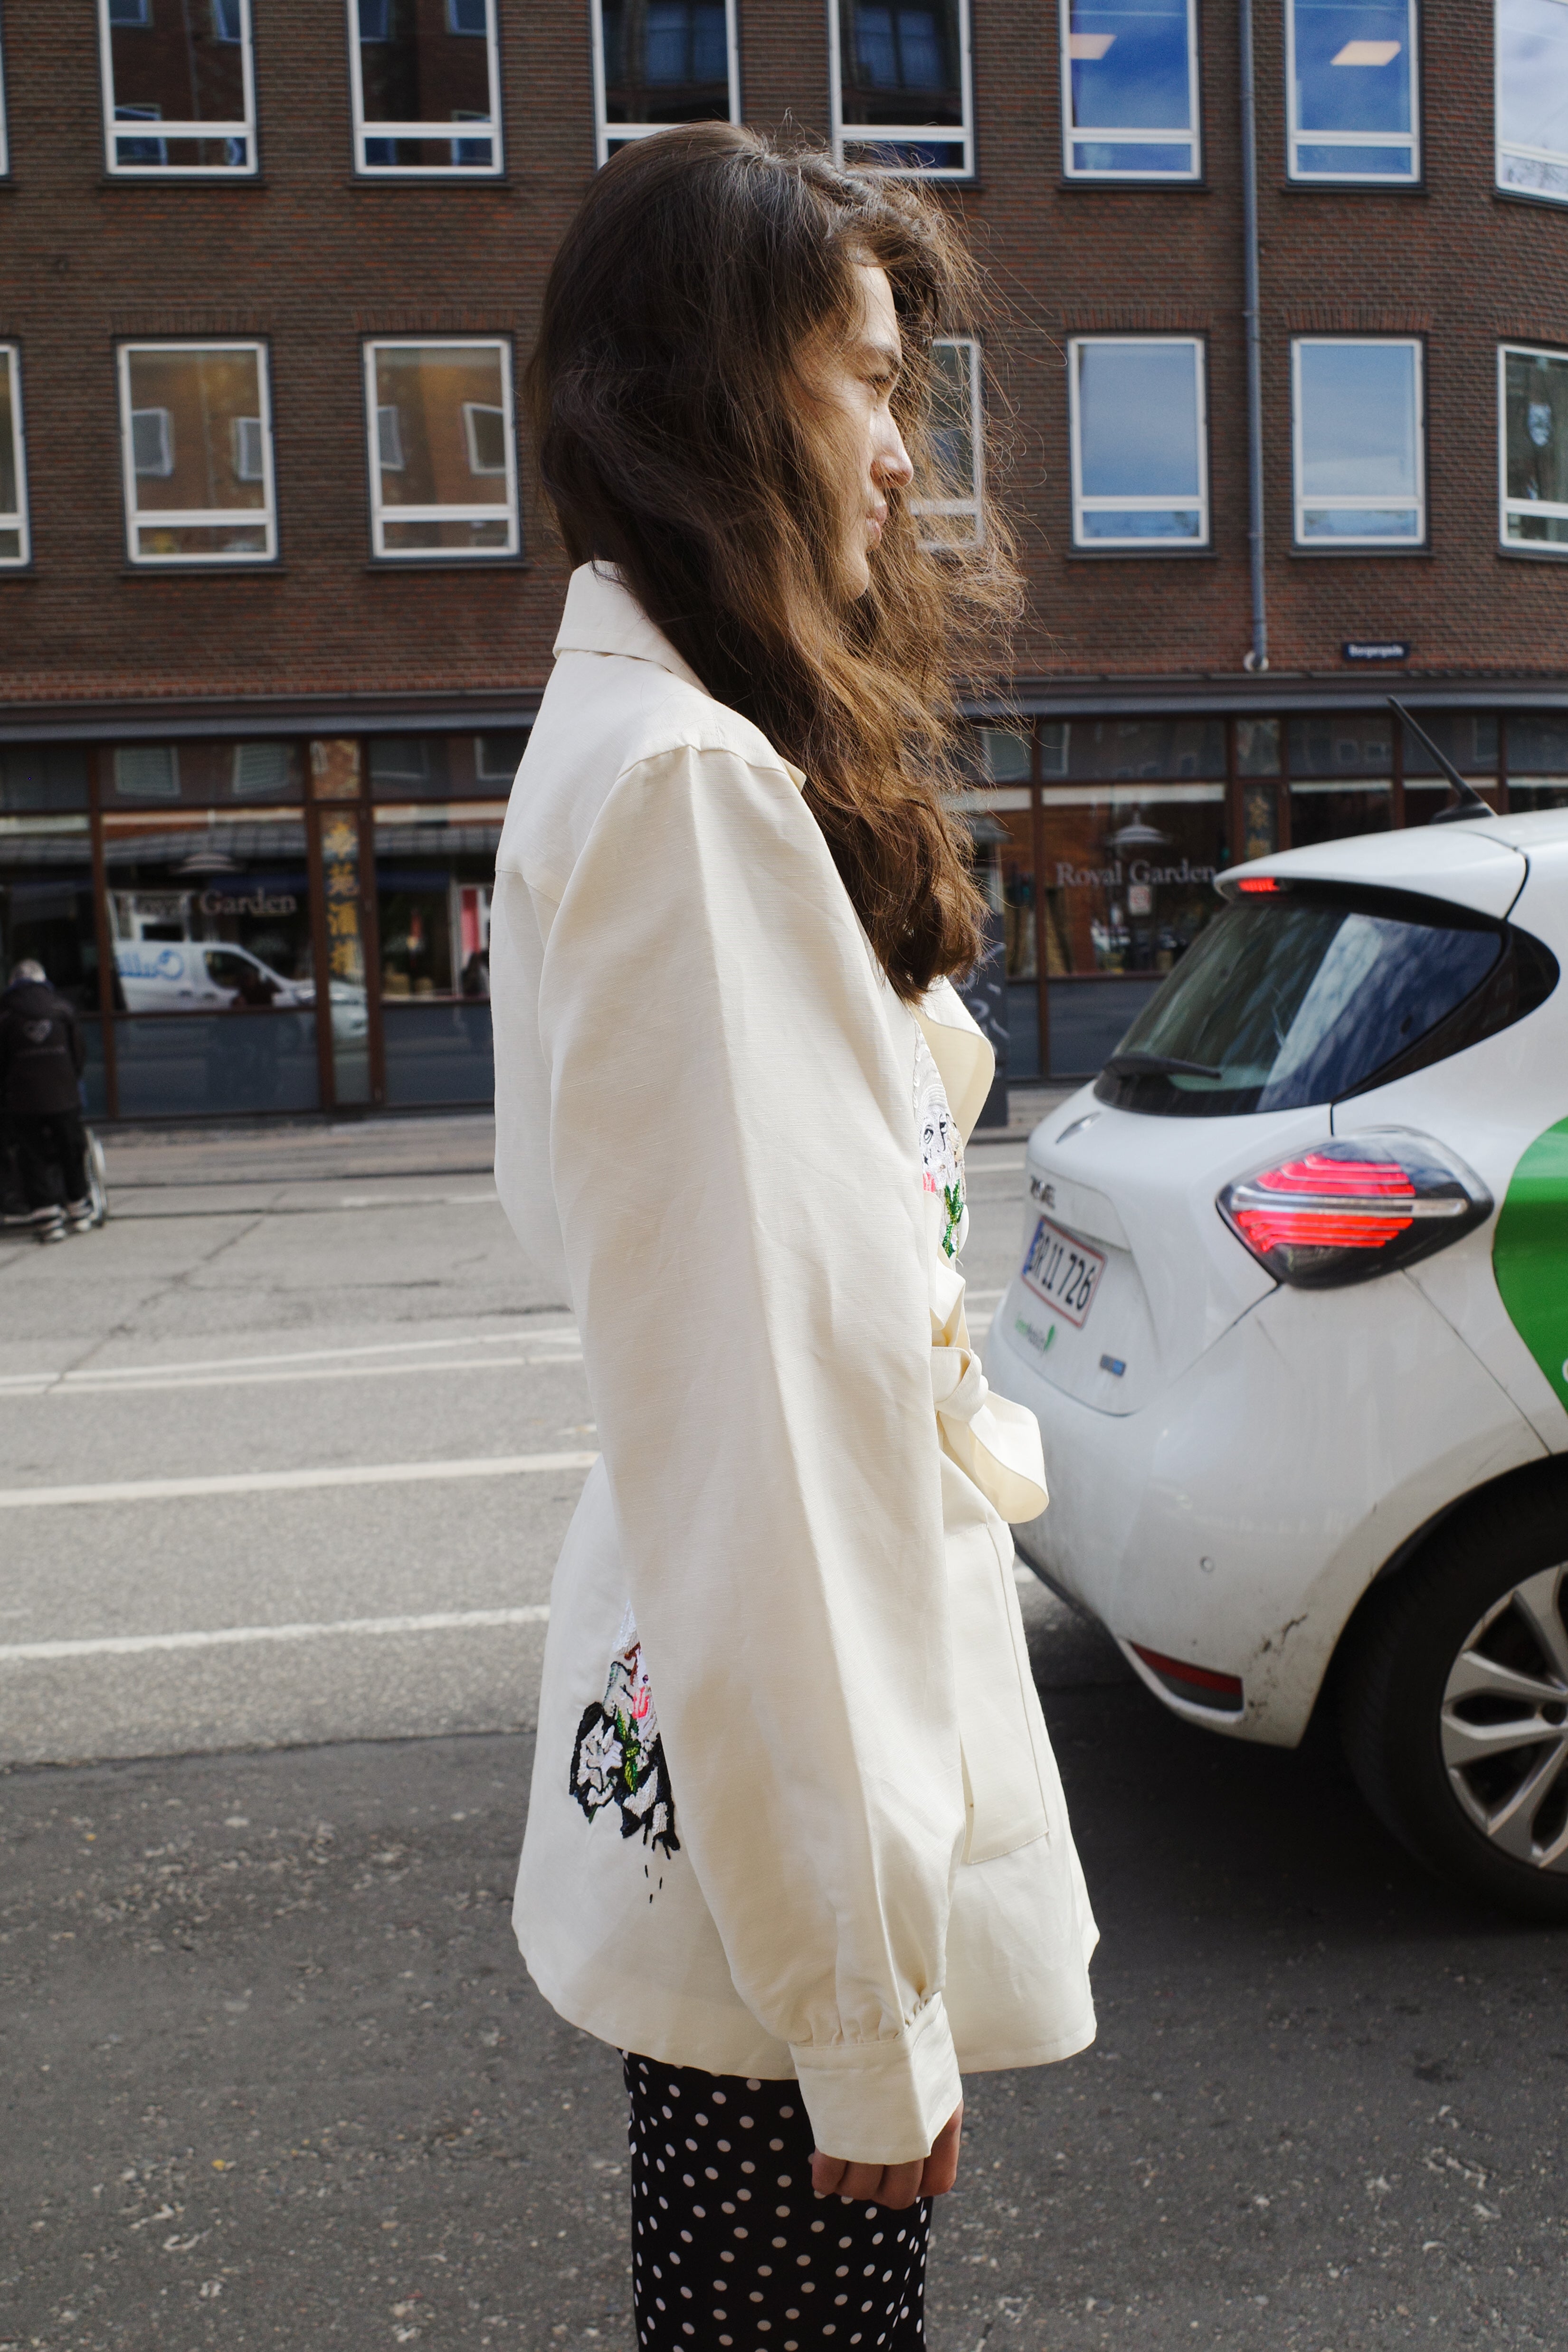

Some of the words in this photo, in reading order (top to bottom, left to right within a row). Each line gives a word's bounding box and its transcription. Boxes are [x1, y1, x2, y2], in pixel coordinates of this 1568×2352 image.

[1055, 860, 1123, 889] Royal
[1128, 858, 1216, 885] Garden
[199, 886, 297, 916] Garden
